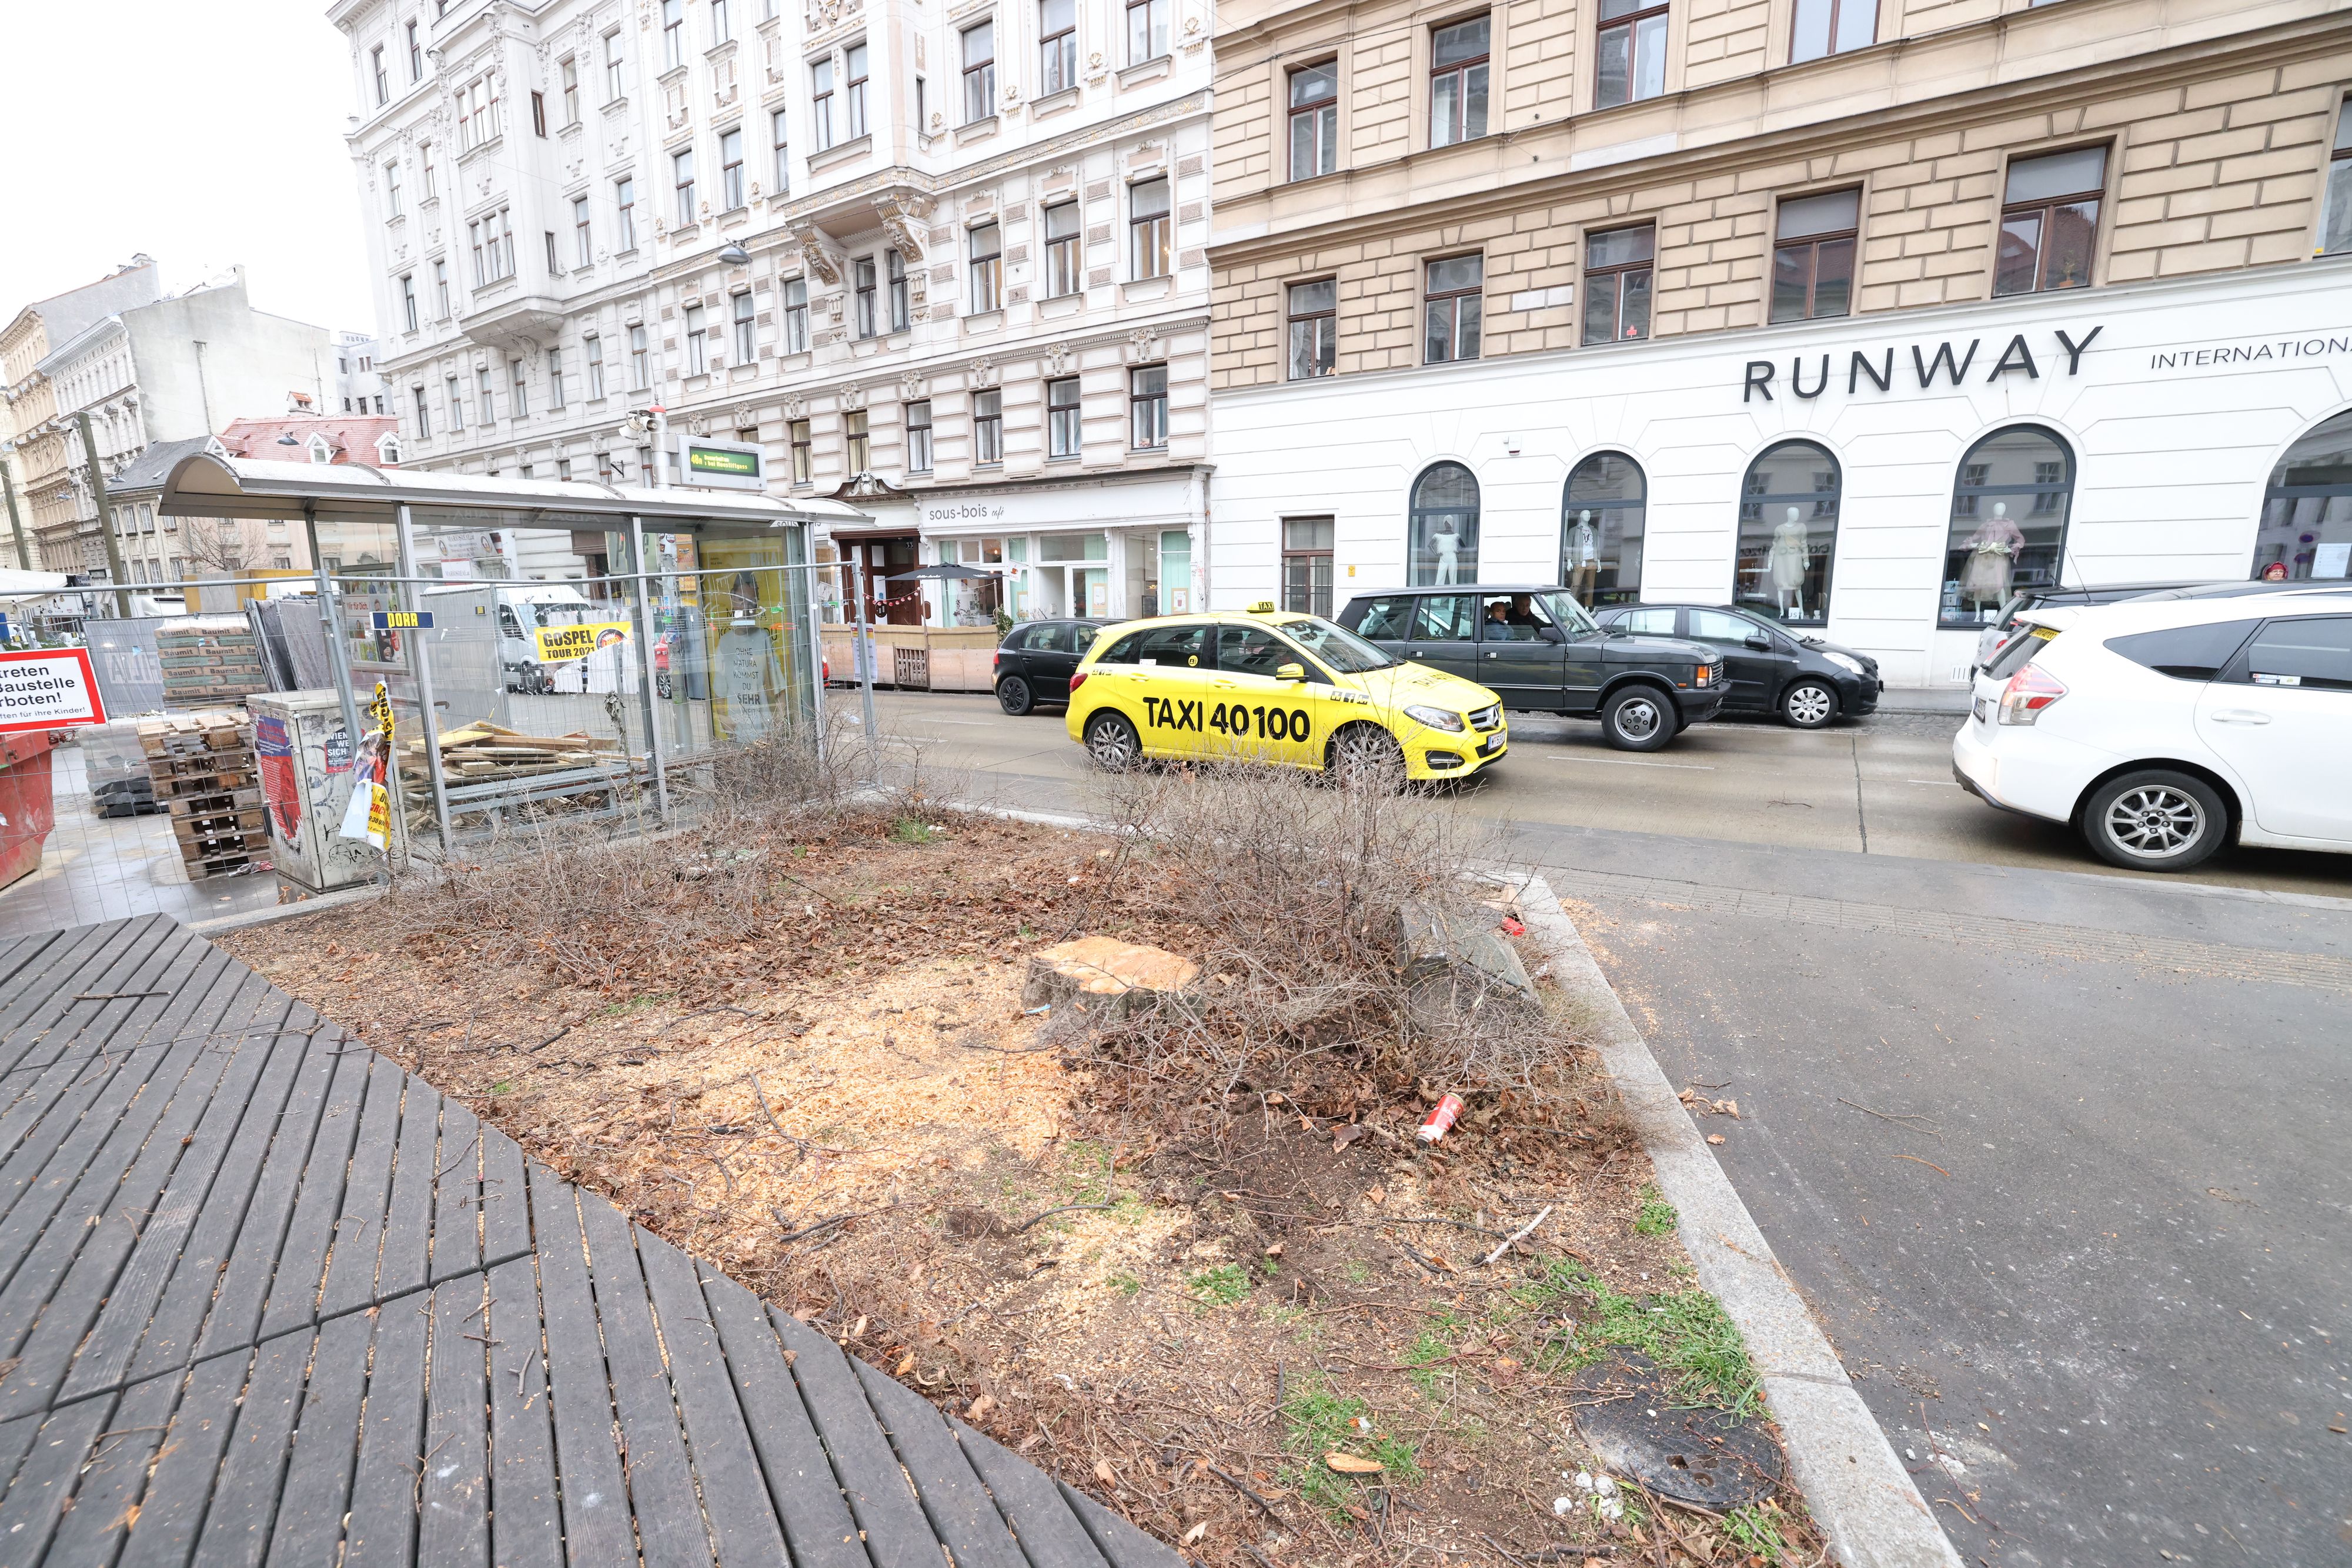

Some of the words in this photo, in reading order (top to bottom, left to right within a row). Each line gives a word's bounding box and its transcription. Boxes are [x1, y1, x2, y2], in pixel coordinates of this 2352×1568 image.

[2151, 337, 2352, 369] INTERNATION
[1743, 326, 2104, 403] RUNWAY
[930, 504, 987, 520] sous-bois
[991, 506, 1004, 520] café
[750, 551, 779, 566] BILLA
[543, 630, 594, 647] GOSPEL
[546, 649, 572, 658] TOUR
[574, 647, 595, 656] 2021
[736, 648, 753, 656] OHNE
[733, 660, 757, 668] MATURA
[733, 671, 759, 680] KOMMST
[742, 683, 751, 691] DU
[0, 692, 62, 707] rboten!
[737, 693, 761, 705] SEHR
[54, 707, 86, 715] Kinder!
[1142, 697, 1203, 733] TAXI
[328, 731, 348, 740] WIEN
[327, 748, 347, 757] SICH
